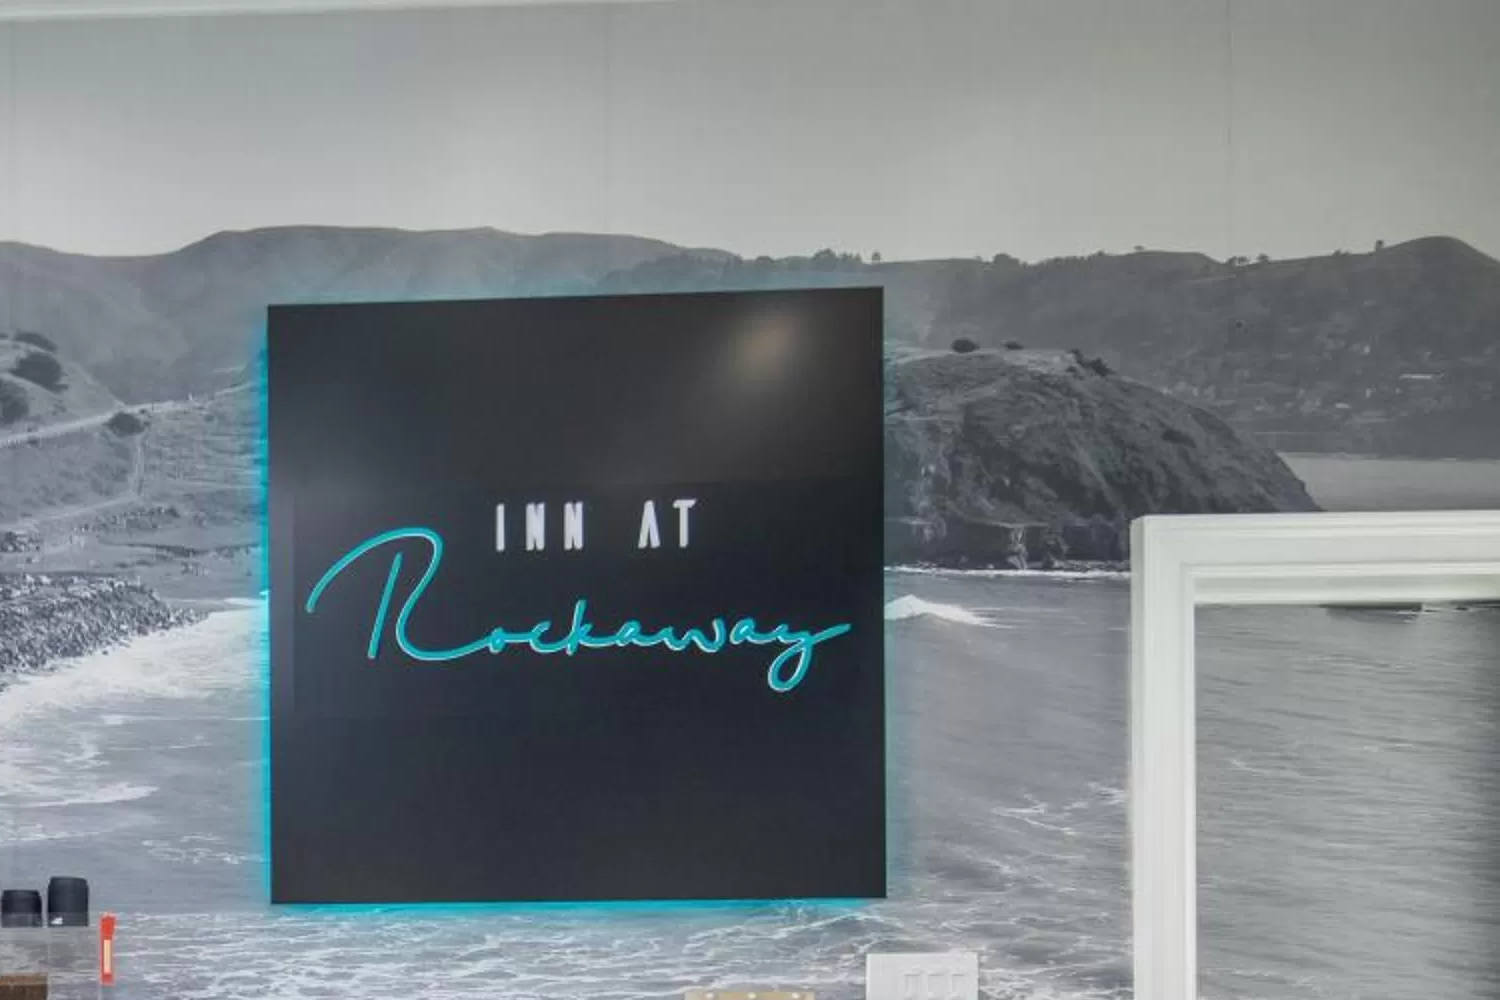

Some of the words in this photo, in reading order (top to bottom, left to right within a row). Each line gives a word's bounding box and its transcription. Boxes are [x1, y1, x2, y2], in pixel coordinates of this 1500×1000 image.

[495, 501, 585, 552] INN
[638, 498, 697, 549] AT
[306, 526, 853, 693] Rockaway
